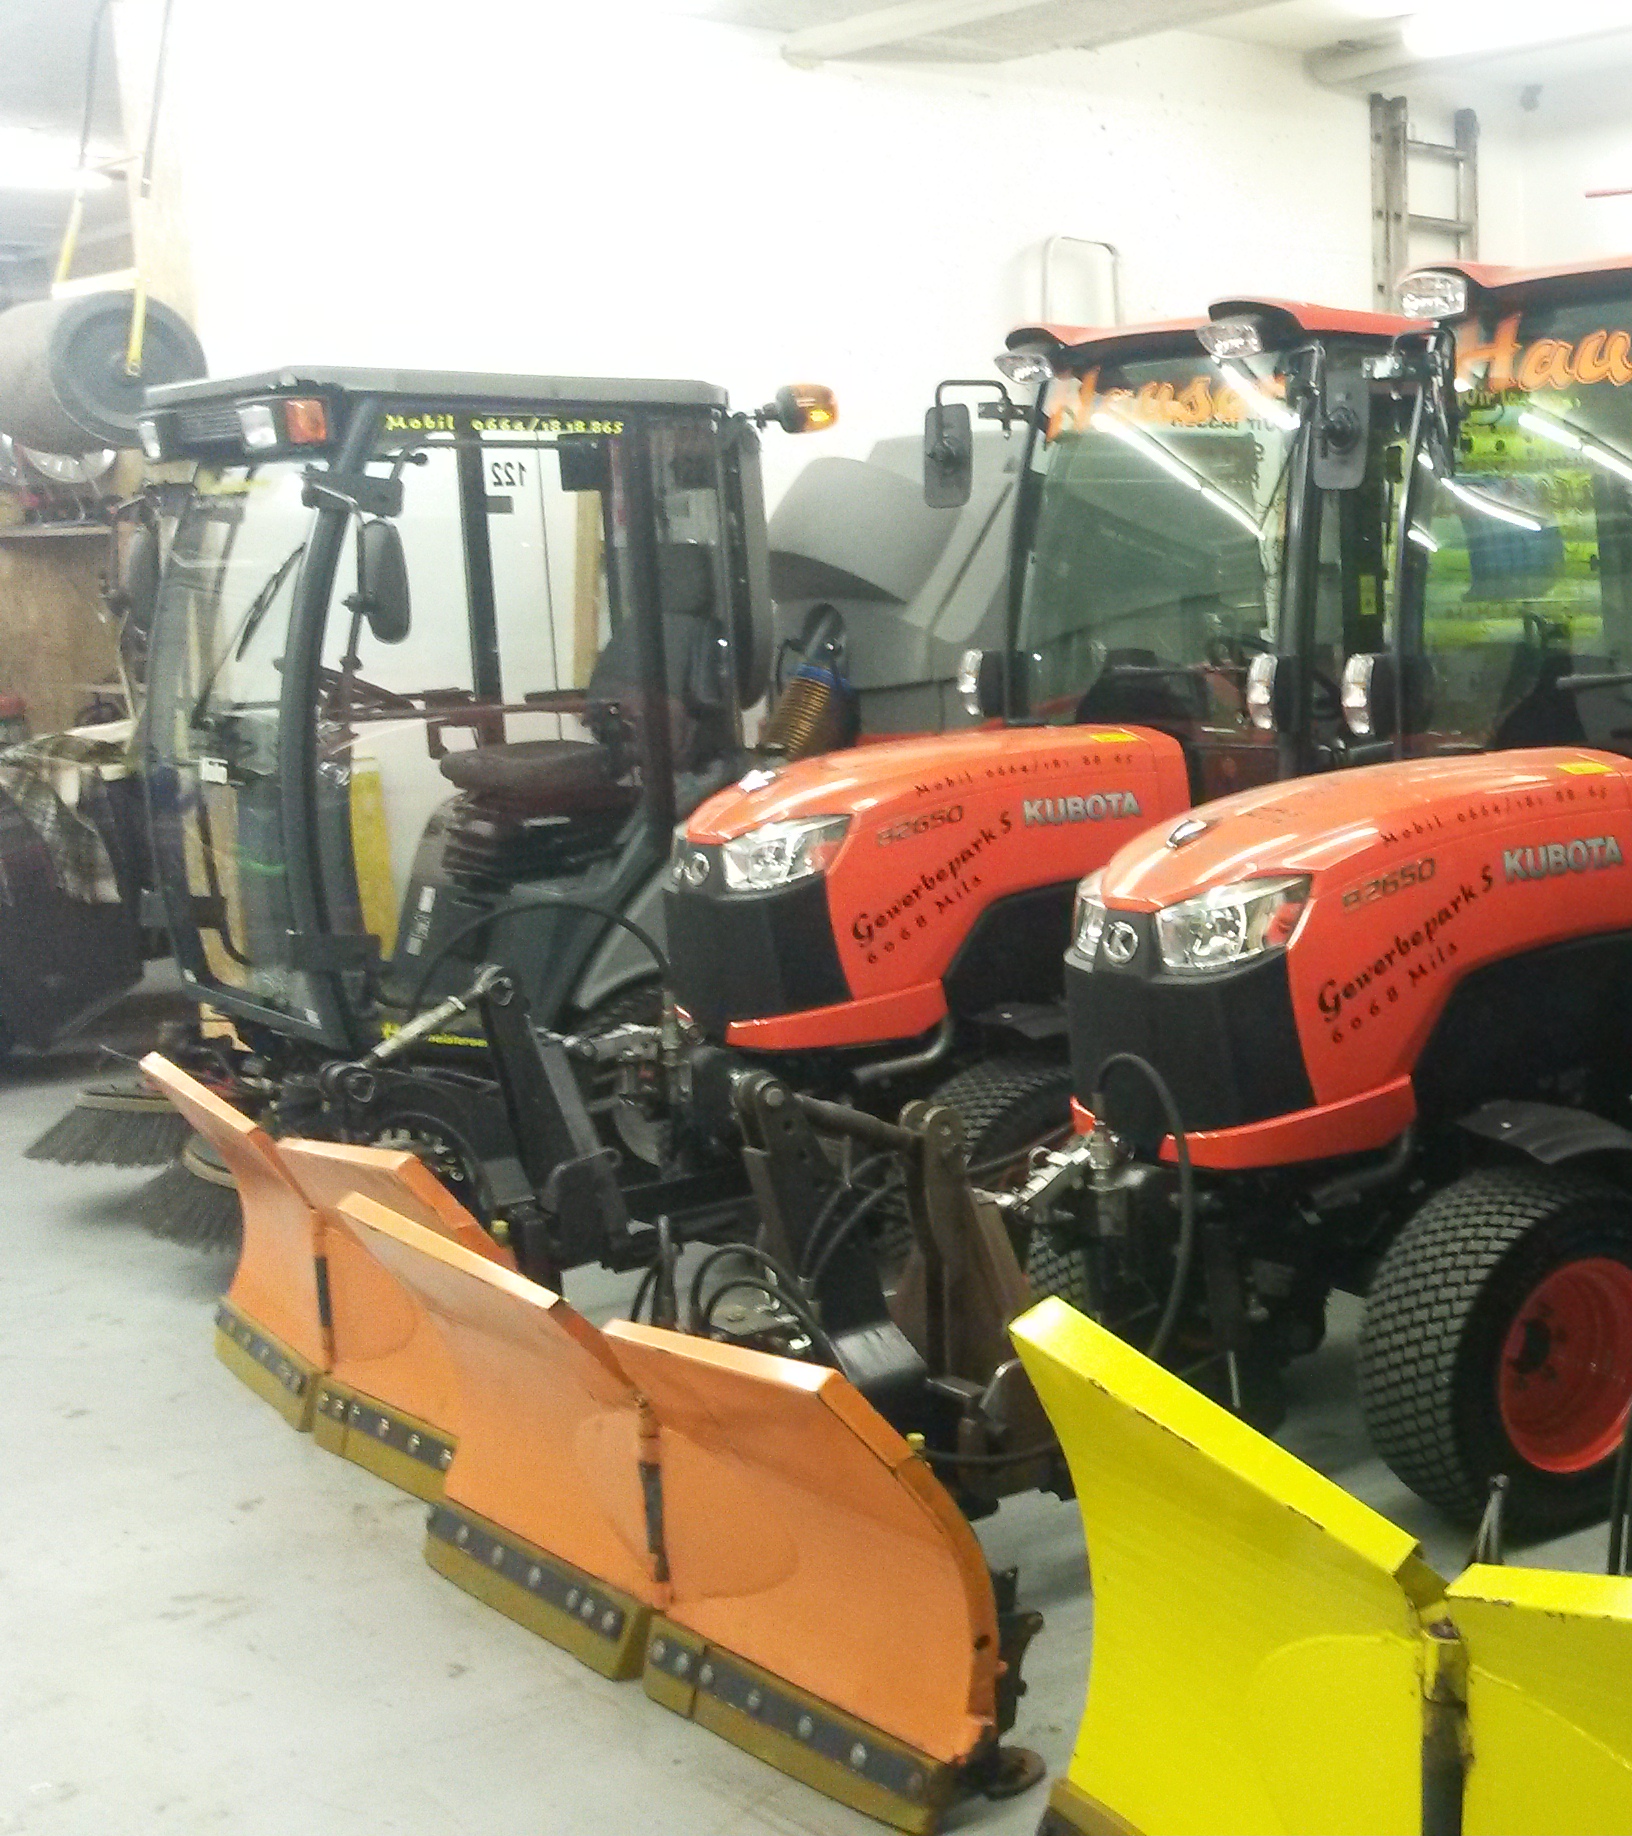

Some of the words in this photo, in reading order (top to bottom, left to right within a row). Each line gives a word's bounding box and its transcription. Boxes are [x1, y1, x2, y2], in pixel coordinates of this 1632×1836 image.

[385, 413, 455, 432] Mobil
[914, 771, 973, 797] Mobil
[1022, 790, 1142, 827] KUBOTA
[1380, 815, 1443, 847] Mobil
[1502, 834, 1624, 884] KUBOTA
[852, 828, 997, 948] Gewerbepark
[935, 875, 982, 914] Mils
[1341, 857, 1435, 915] B2650
[1318, 884, 1479, 1023] Gewerbepark
[1332, 985, 1399, 1044] 6068
[1408, 942, 1457, 988] Mils
